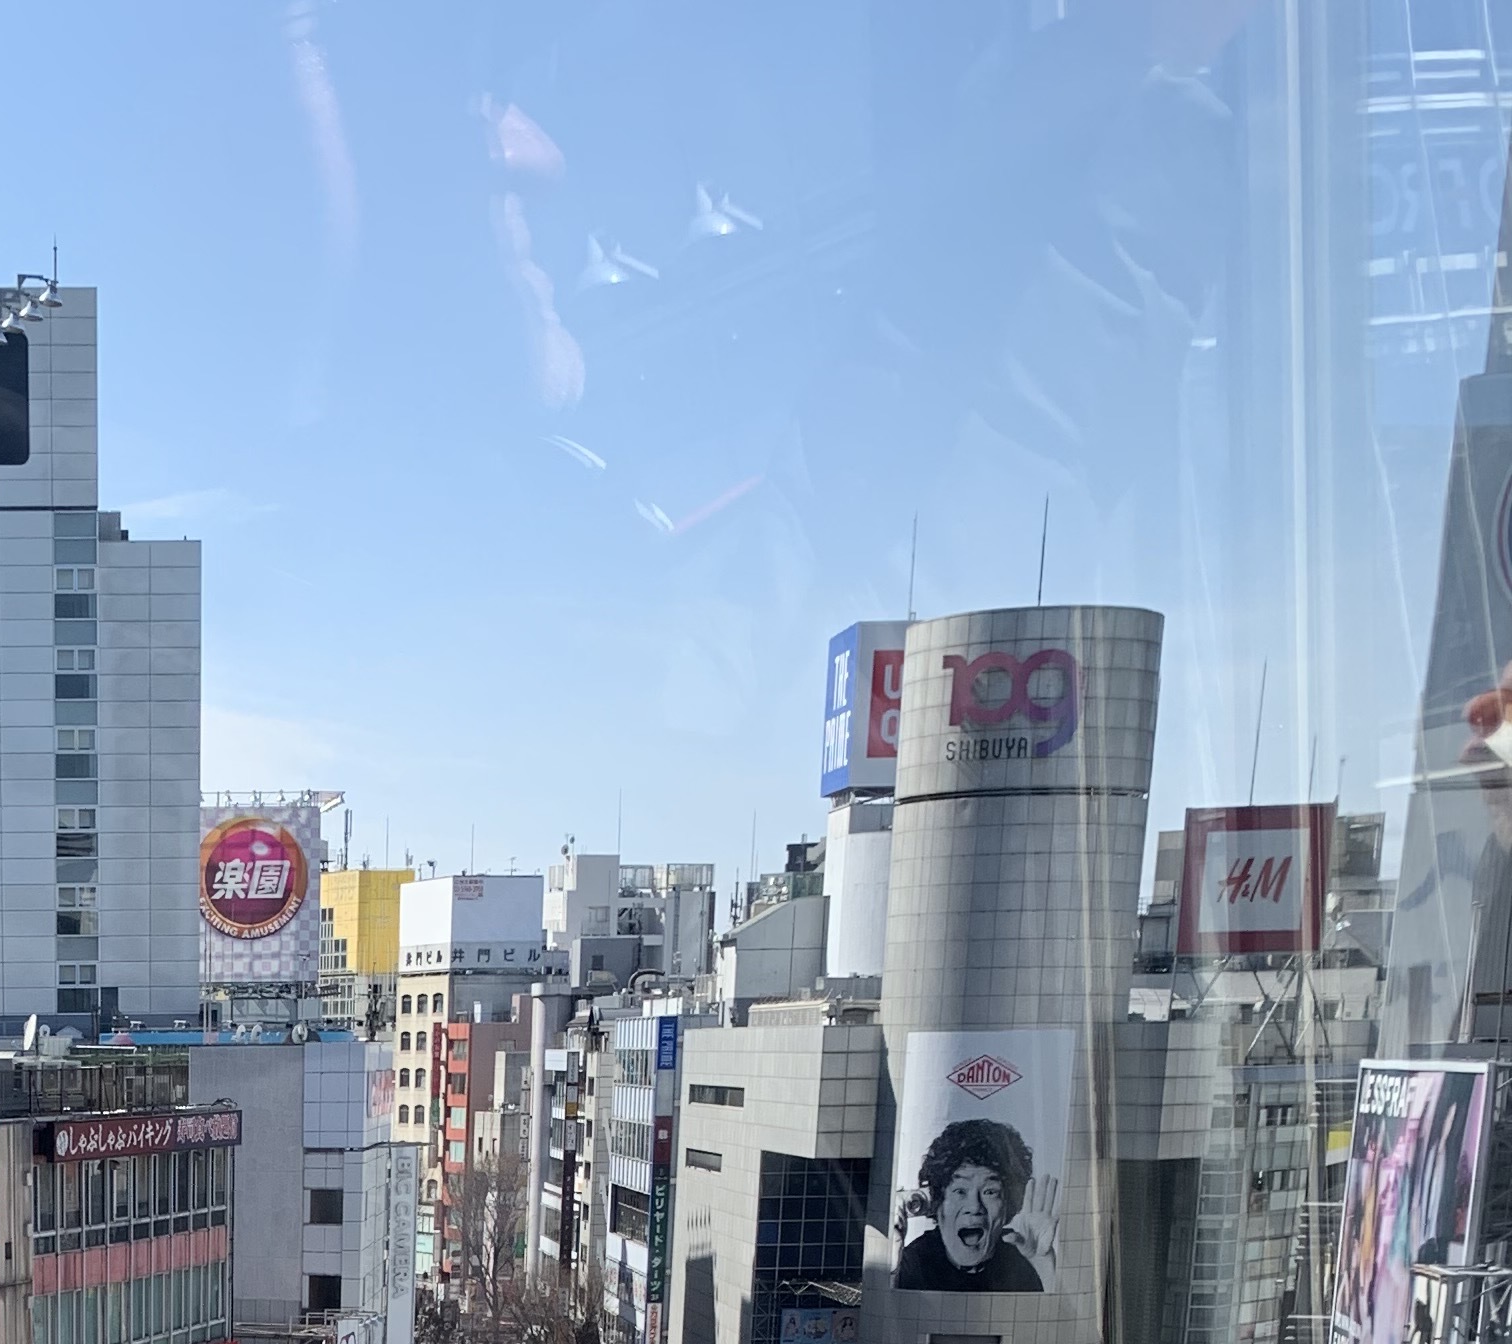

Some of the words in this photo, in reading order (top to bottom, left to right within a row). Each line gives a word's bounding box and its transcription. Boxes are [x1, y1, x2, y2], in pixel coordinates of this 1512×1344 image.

[833, 651, 850, 711] THE
[942, 648, 1079, 759] 109
[823, 710, 852, 775] PRIME
[945, 737, 1029, 762] SHIBUYA
[211, 858, 291, 900] 楽園
[1216, 856, 1293, 906] H&M
[241, 897, 304, 940] AMUSEMENT
[451, 947, 541, 963] 井門ビル
[660, 1022, 676, 1039] THE
[957, 1058, 1011, 1084] DANTON
[70, 1117, 173, 1155] しゃぶしゃぶバイキング
